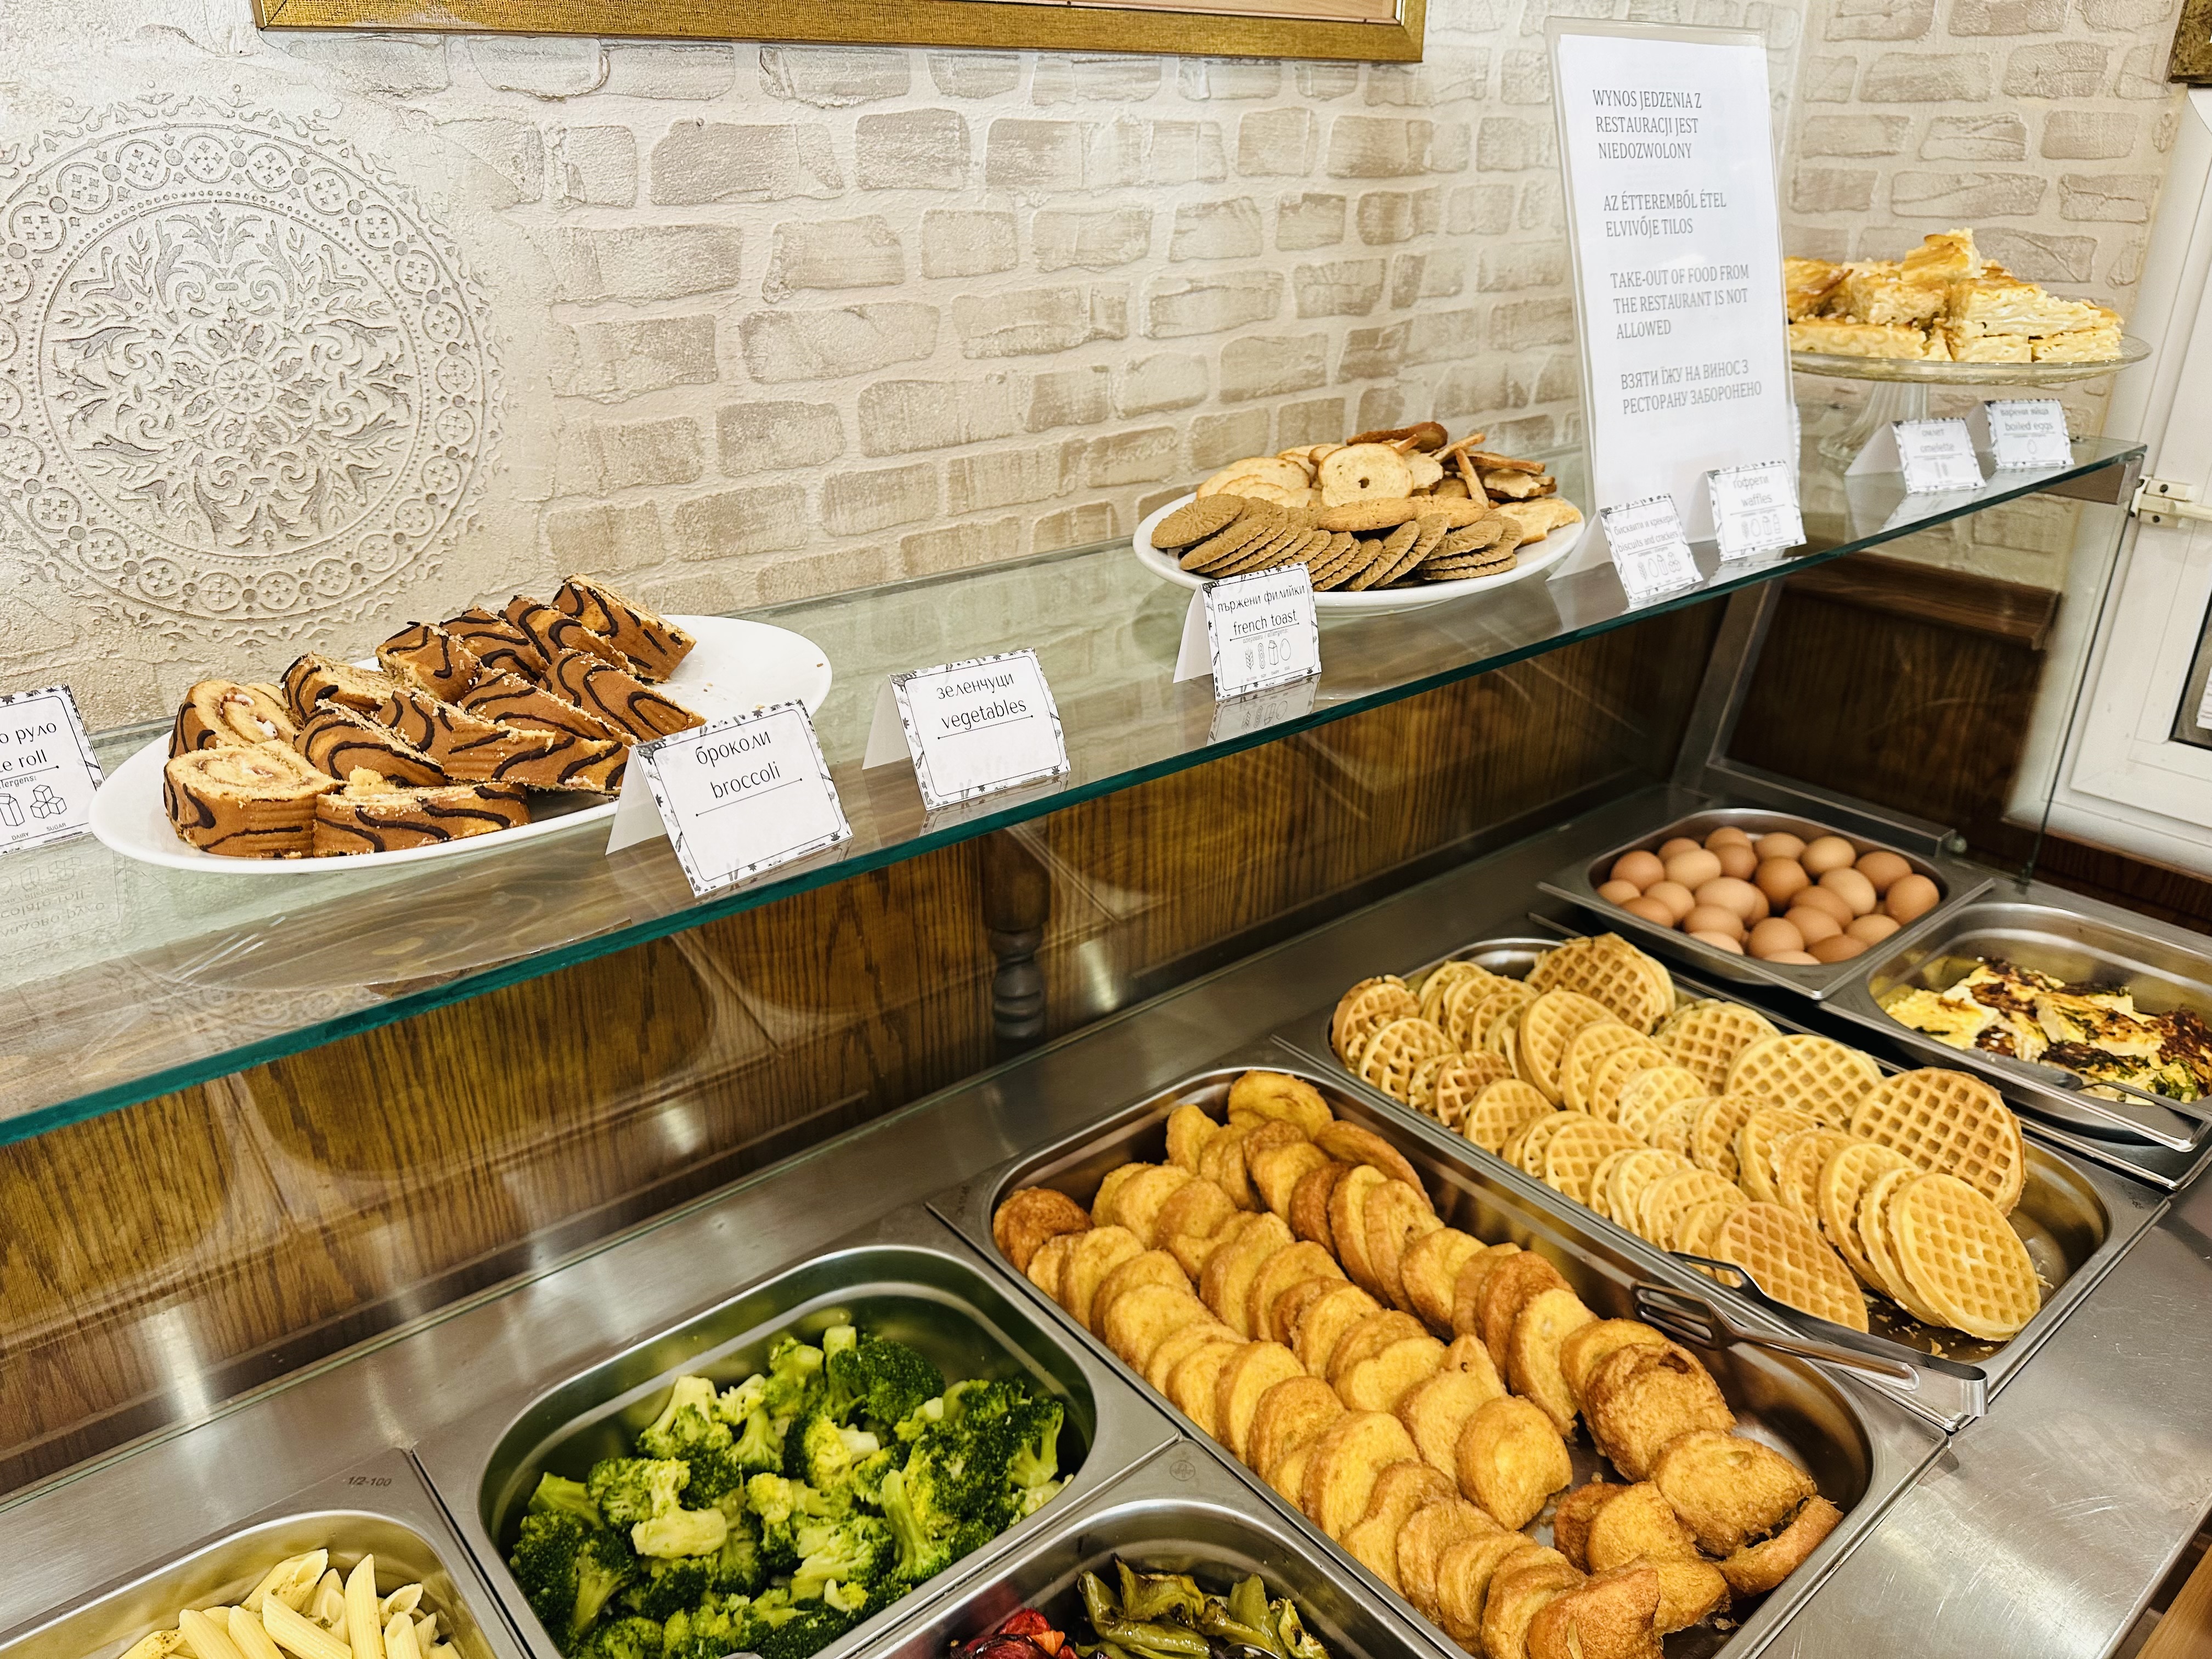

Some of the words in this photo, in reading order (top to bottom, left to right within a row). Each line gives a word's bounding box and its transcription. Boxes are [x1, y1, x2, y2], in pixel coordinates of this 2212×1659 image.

[1593, 89, 1637, 107] WYNOS
[1640, 91, 1693, 110] JEDZENIA
[1695, 93, 1702, 108] Z
[1596, 116, 1673, 136] RESTAURACJI
[1675, 117, 1699, 137] JEST
[1598, 143, 1692, 159] NIEDOZWOLONY
[1604, 195, 1618, 211] AZ
[1621, 189, 1697, 211] ÉTTEREMBŐL
[1700, 189, 1727, 208] ÉTEL
[1606, 216, 1660, 239] ELVIVŐJE
[1661, 218, 1693, 235] TILOS
[1610, 269, 1668, 289] TAKE-OUT
[1671, 268, 1685, 284] OF
[1688, 266, 1717, 284] FOOD
[1720, 264, 1750, 280] FROM
[1613, 297, 1638, 314] THE
[1640, 291, 1712, 312] RESTAURANT
[1714, 290, 1725, 306] IS
[1726, 288, 1748, 304] NOT
[1616, 319, 1671, 339] ALLOWED
[1621, 370, 1659, 390] ВЗЯТИ
[1660, 365, 1683, 385] ЇЖУ
[1685, 365, 1701, 381] НА
[1703, 360, 1740, 380] ВИНОС
[1742, 359, 1749, 374] З
[1623, 390, 1688, 415] РЕСТОРАНУ
[1690, 381, 1762, 406] ЗАБОРОНЕНО
[2005, 421, 2032, 431] boiled
[2033, 422, 2054, 432] eggs
[1741, 493, 1773, 507] waffles
[1613, 522, 1644, 536] бисквити
[1650, 515, 1674, 528] крекери
[1617, 539, 1644, 552] biscuits
[1644, 535, 1655, 545] and
[1655, 531, 1679, 543] crackers
[1217, 594, 1261, 614] пържени
[1264, 584, 1305, 605] филийки
[1233, 615, 1267, 636] french
[1271, 608, 1297, 627] toast
[936, 673, 1014, 700] зеленчуци
[941, 699, 1026, 730] vegetables
[15, 723, 57, 744] руло
[19, 749, 47, 768] roll
[695, 730, 771, 768] броколи
[0, 775, 37, 789] lergens:
[710, 760, 781, 799] broccoli
[12, 832, 29, 840] DAIRY
[46, 822, 66, 832] SUGAR
[348, 1476, 392, 1487] 1/2-100
